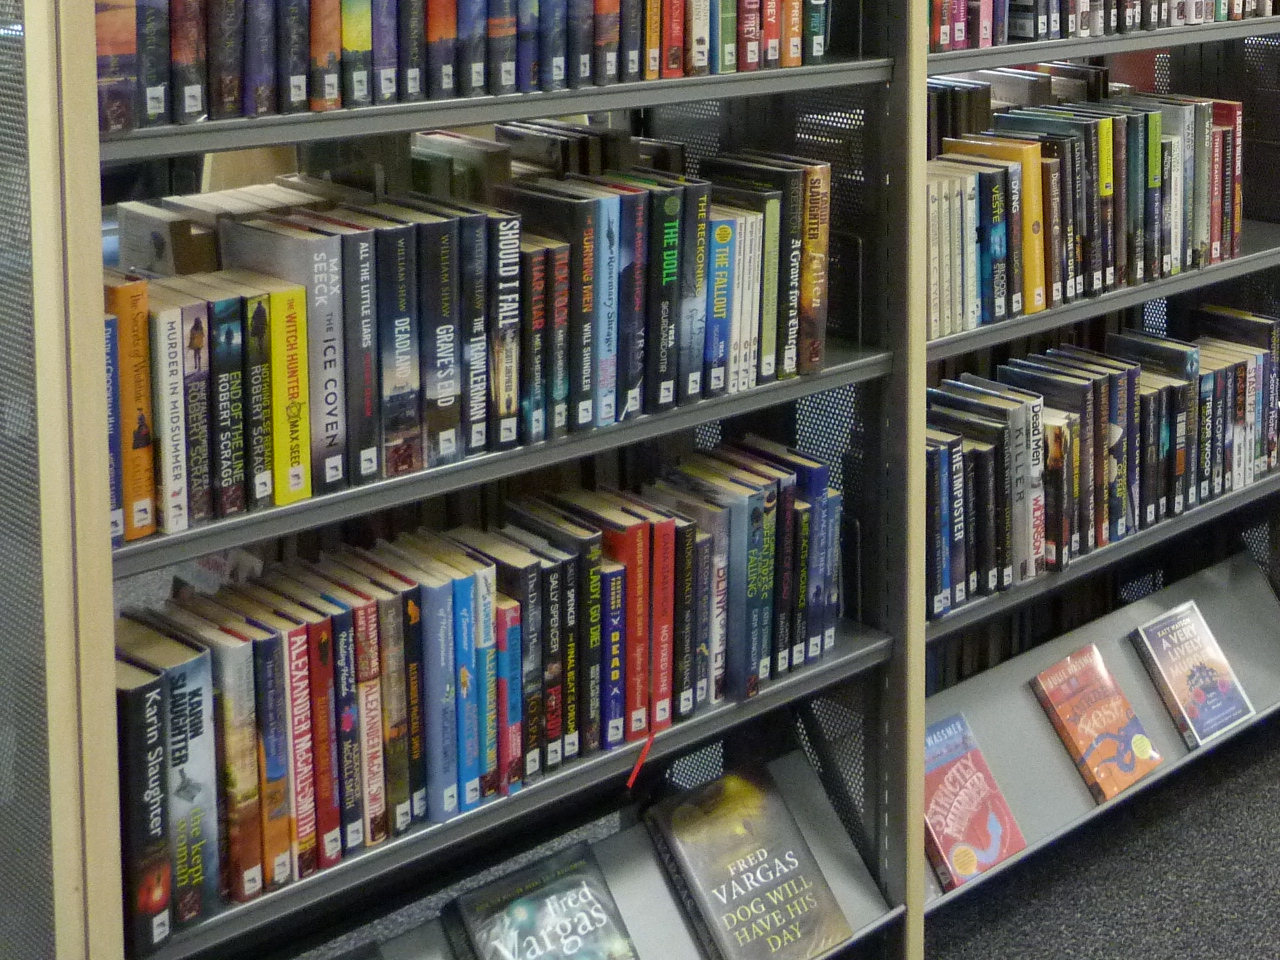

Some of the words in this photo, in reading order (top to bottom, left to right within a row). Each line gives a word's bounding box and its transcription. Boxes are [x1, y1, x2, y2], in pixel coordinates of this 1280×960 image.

[744, 13, 756, 39] PREY
[791, 1, 800, 33] PREY
[811, 13, 820, 33] PREY
[697, 195, 707, 219] THE
[807, 178, 821, 239] SLAUGHTER
[992, 185, 1000, 223] VESTE
[1012, 180, 1020, 213] DYING
[498, 220, 519, 277] SHOULD
[664, 219, 679, 246] THE
[359, 242, 370, 260] ALL
[582, 228, 594, 282] BURNING
[662, 250, 678, 285] DOLL
[695, 221, 707, 297] RECKONING
[715, 247, 729, 269] THE
[313, 252, 328, 307] SEECK
[327, 258, 340, 296] MAX
[360, 262, 370, 282] THE
[499, 281, 519, 290] I
[531, 256, 544, 291] LIAR
[810, 250, 825, 307] fallen
[361, 284, 371, 316] LITTLE
[499, 294, 519, 328] FALL
[581, 285, 593, 312] MEN
[713, 271, 728, 319] FALLOUT
[325, 312, 333, 333] THE
[473, 316, 484, 333] THE
[531, 295, 544, 331] LIAR
[166, 321, 179, 376] MURDER
[286, 312, 298, 352] WITCH
[362, 319, 371, 348] LIARS
[582, 323, 592, 344] WILL
[322, 338, 338, 370] ICE
[435, 325, 454, 378] GRAVE'S
[582, 346, 592, 391] SHINDLER
[169, 379, 179, 396] IN
[229, 371, 242, 397] END
[287, 354, 300, 400] HUNTER
[437, 381, 454, 407] END
[470, 333, 486, 421] TRAWLERMAN
[219, 372, 232, 430] ROBERT
[230, 402, 242, 419] OF
[324, 378, 339, 449] COVEN
[231, 423, 243, 447] THE
[288, 420, 300, 441] MAX
[1031, 404, 1041, 436] Dead
[169, 400, 182, 481] MIDSUMMER
[290, 445, 301, 467] SEEC
[952, 444, 962, 470] THE
[1032, 438, 1042, 466] Men
[220, 433, 232, 488] SCRAGG
[232, 450, 244, 482] LINE
[1015, 427, 1025, 503] KILLER
[953, 472, 964, 541] IMPOSTER
[1032, 495, 1042, 555] WILKINSON
[549, 573, 559, 601] SALLY
[587, 567, 601, 601] LADY,
[747, 549, 757, 598] FALLING
[550, 604, 559, 653] SPENCER
[590, 607, 600, 622] GO
[589, 624, 601, 649] DIE!
[660, 624, 668, 640] NO
[1162, 639, 1171, 650] A
[1170, 623, 1198, 644] VERY
[660, 641, 668, 668] FIXED
[288, 634, 310, 733] ALEXANDER
[660, 670, 668, 693] LINE
[144, 688, 163, 744] Karin
[169, 671, 189, 768] SLAUGHTER
[188, 686, 204, 740] KARIN
[926, 721, 964, 747] WASSMER
[143, 746, 164, 836] Slaughter
[930, 752, 977, 831] STRICTLY
[189, 808, 206, 836] the
[294, 783, 315, 836] SMITH
[176, 817, 190, 887] woman
[189, 839, 206, 886] kept
[727, 848, 768, 876] FRED
[712, 850, 798, 904] VARGAS
[545, 881, 597, 918] Fred
[720, 897, 766, 930] DOG
[766, 875, 813, 905] WILL
[491, 904, 608, 960] Vargas
[733, 909, 786, 947] HAVE
[787, 892, 818, 918] HIS
[766, 921, 801, 954] DAY
